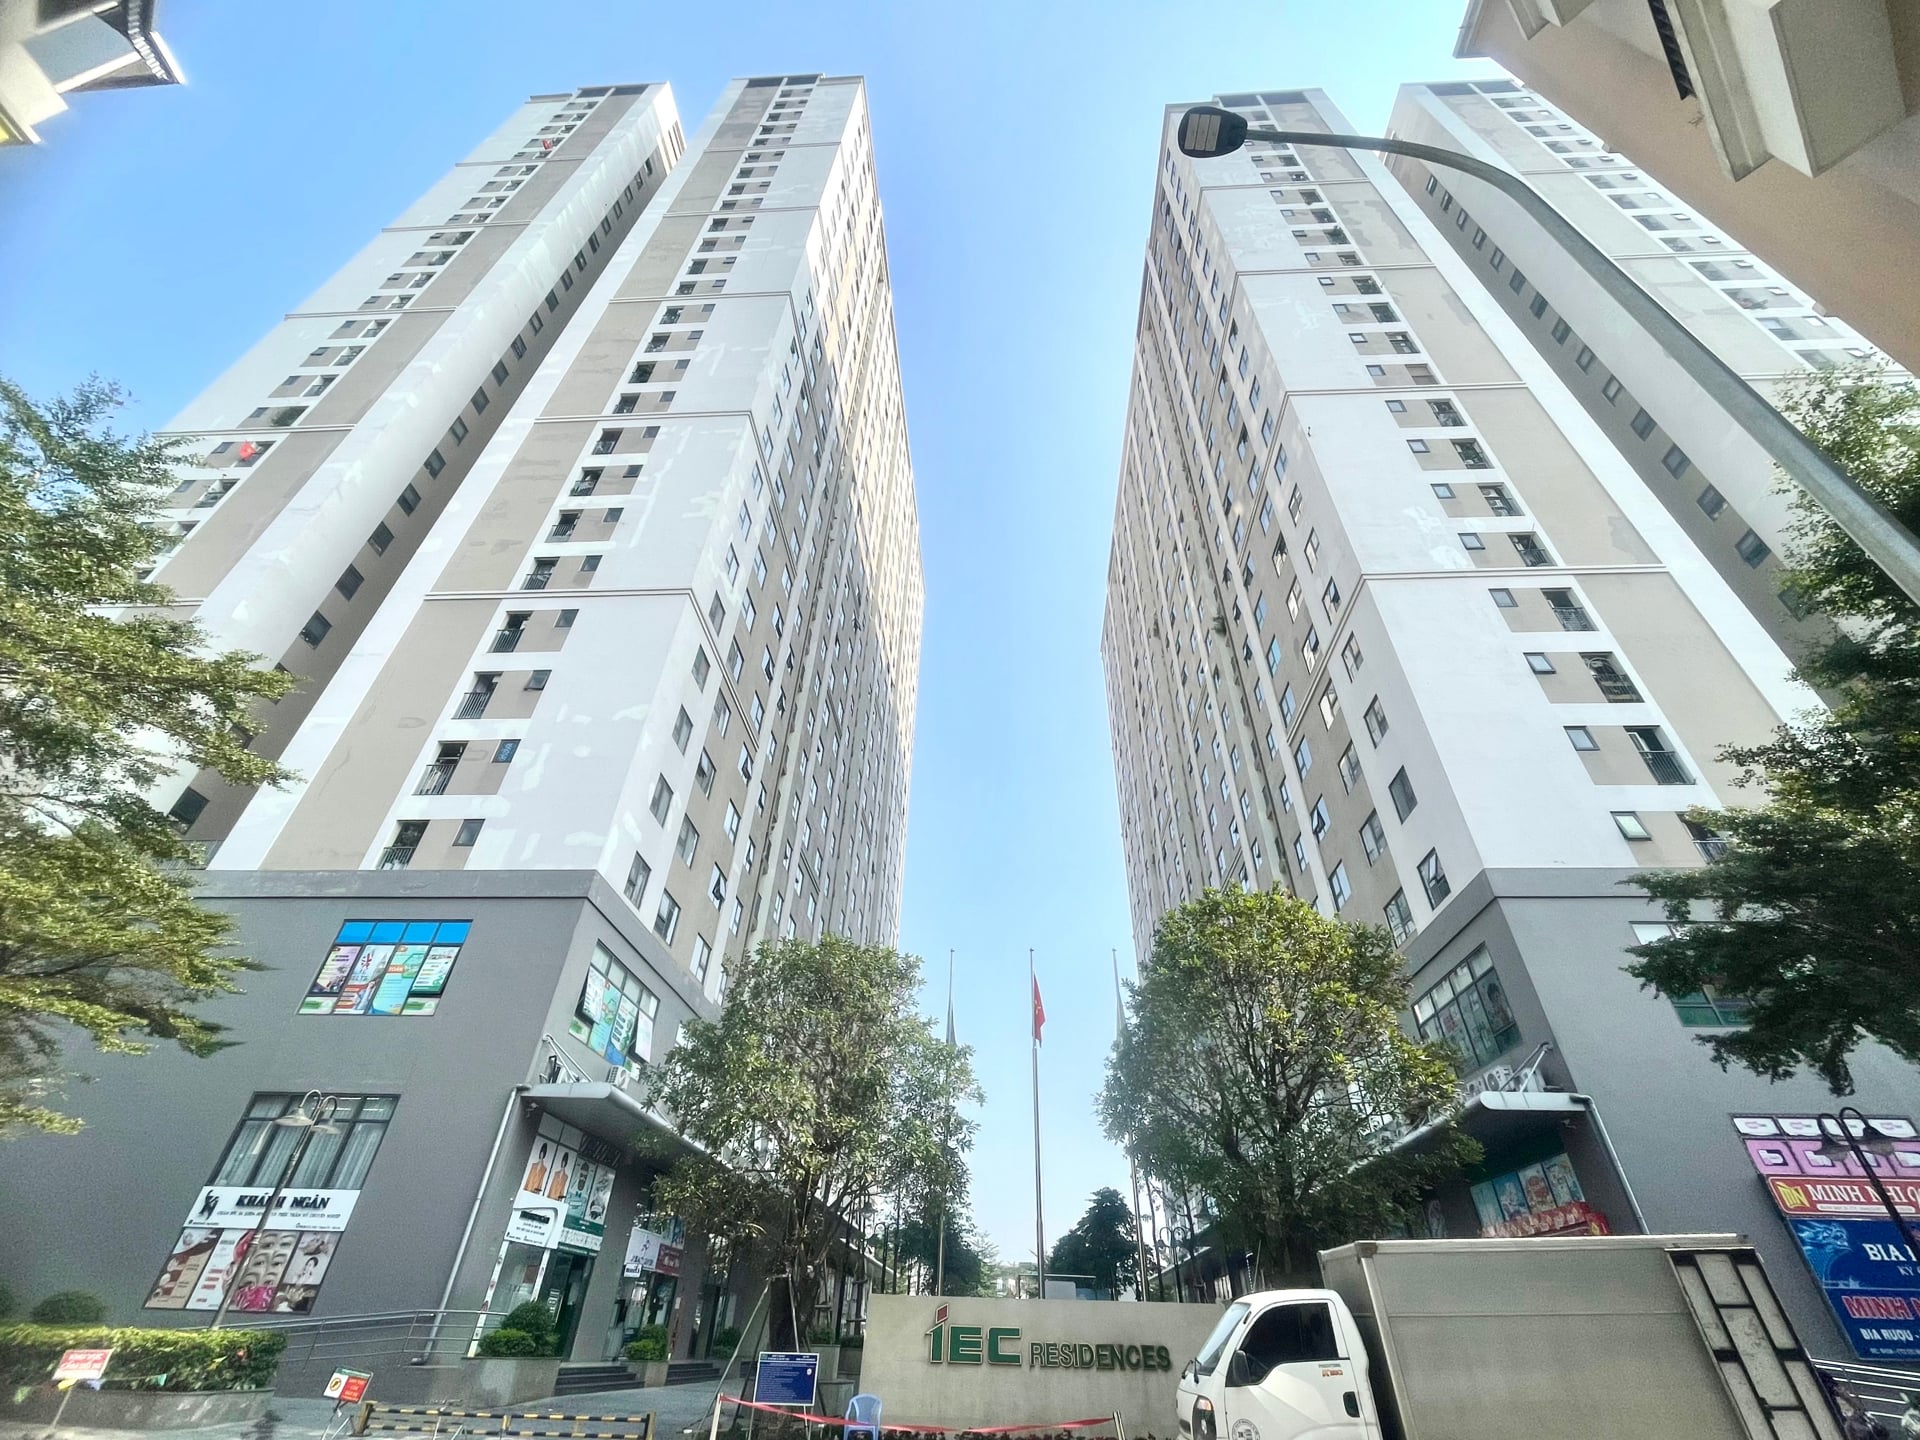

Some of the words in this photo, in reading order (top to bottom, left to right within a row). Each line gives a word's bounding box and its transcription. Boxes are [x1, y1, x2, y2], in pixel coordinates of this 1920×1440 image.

[1805, 1184, 1866, 1202] MINH
[1862, 1243, 1907, 1261] BIA
[1841, 1295, 1915, 1320] MINH
[1859, 1327, 1882, 1341] BIA
[1029, 1341, 1171, 1371] RESIDENCES
